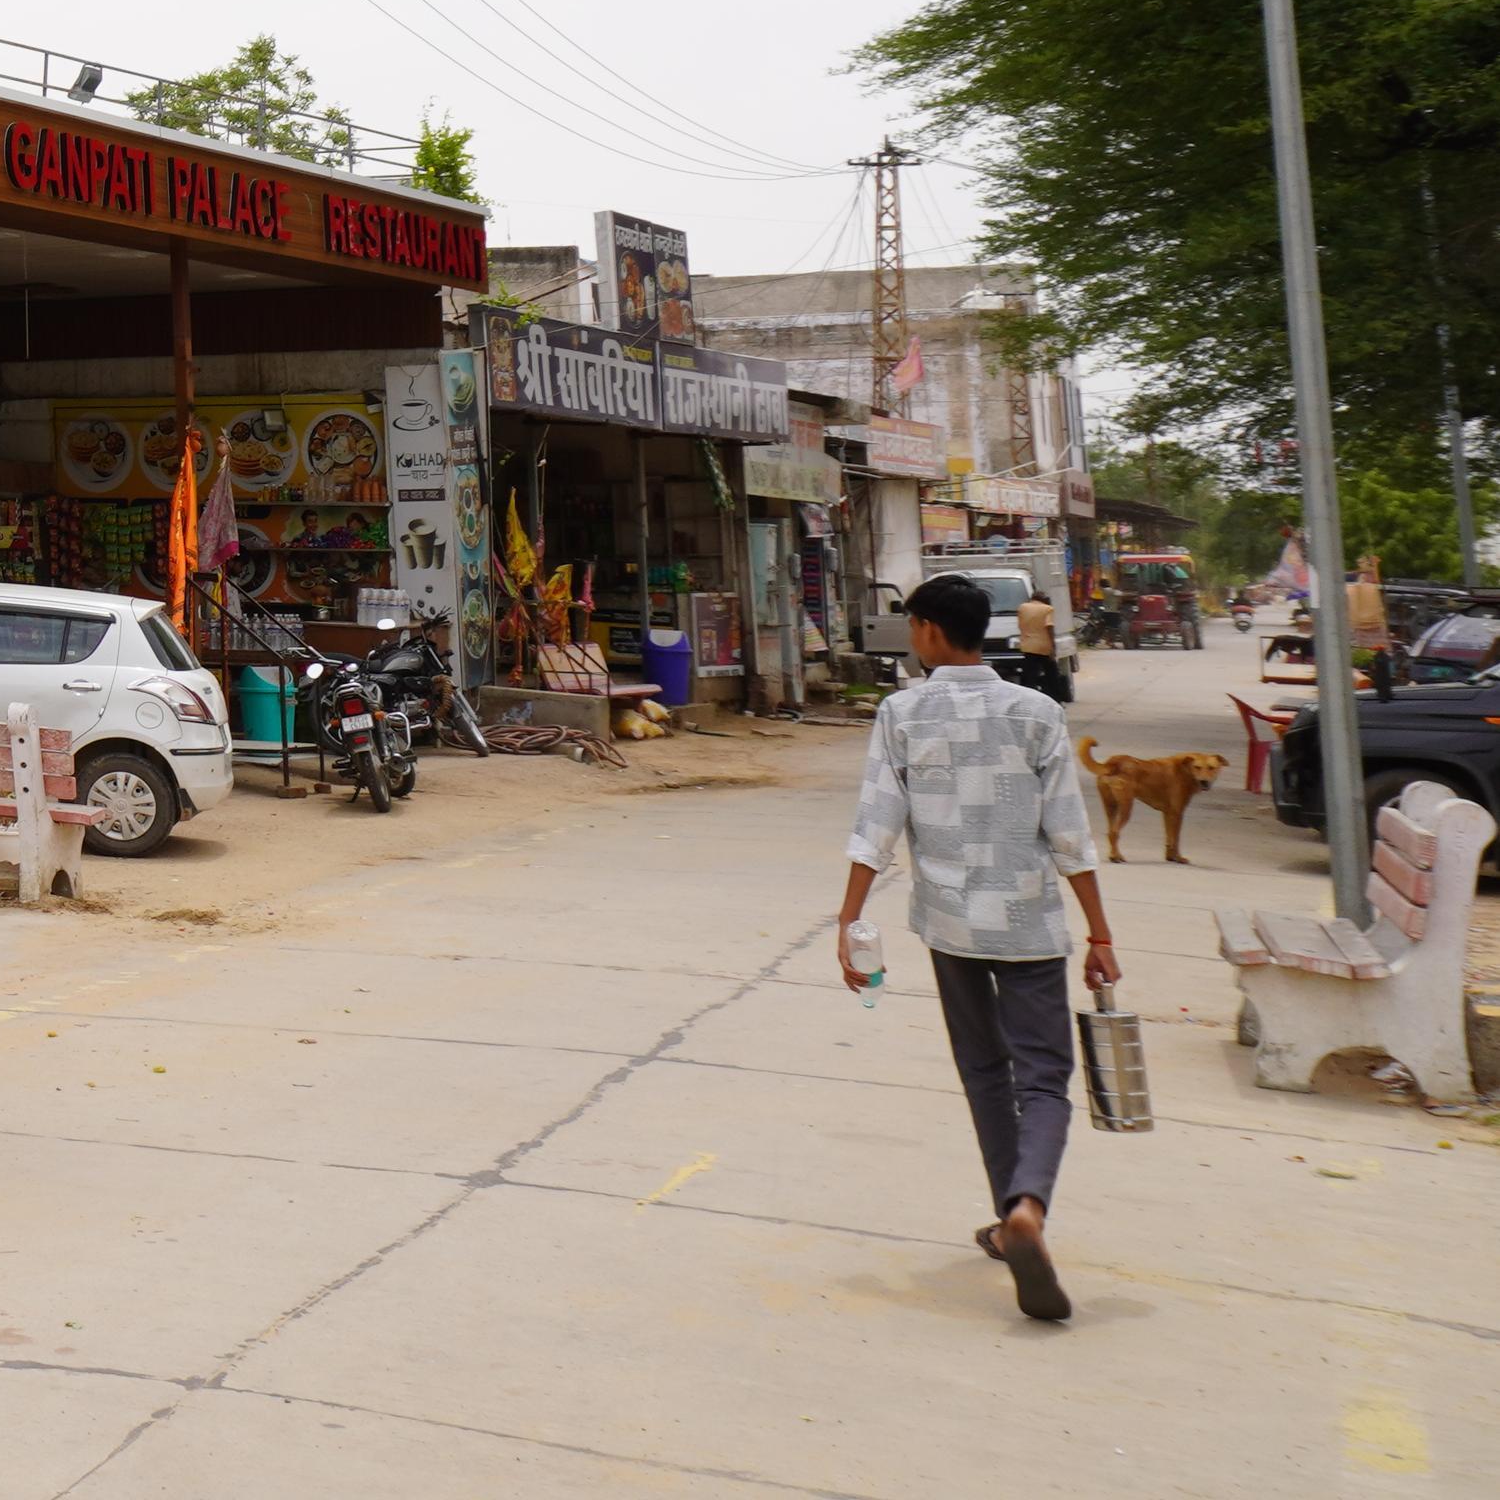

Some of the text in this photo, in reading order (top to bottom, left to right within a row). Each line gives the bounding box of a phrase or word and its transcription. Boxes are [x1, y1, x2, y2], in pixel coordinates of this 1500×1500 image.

[4, 119, 154, 218] GANPATI
[167, 153, 293, 242] PALACE
[324, 192, 487, 283] RESTAURANT
[516, 324, 554, 406] श्री
[663, 362, 751, 434] राजस्थानी
